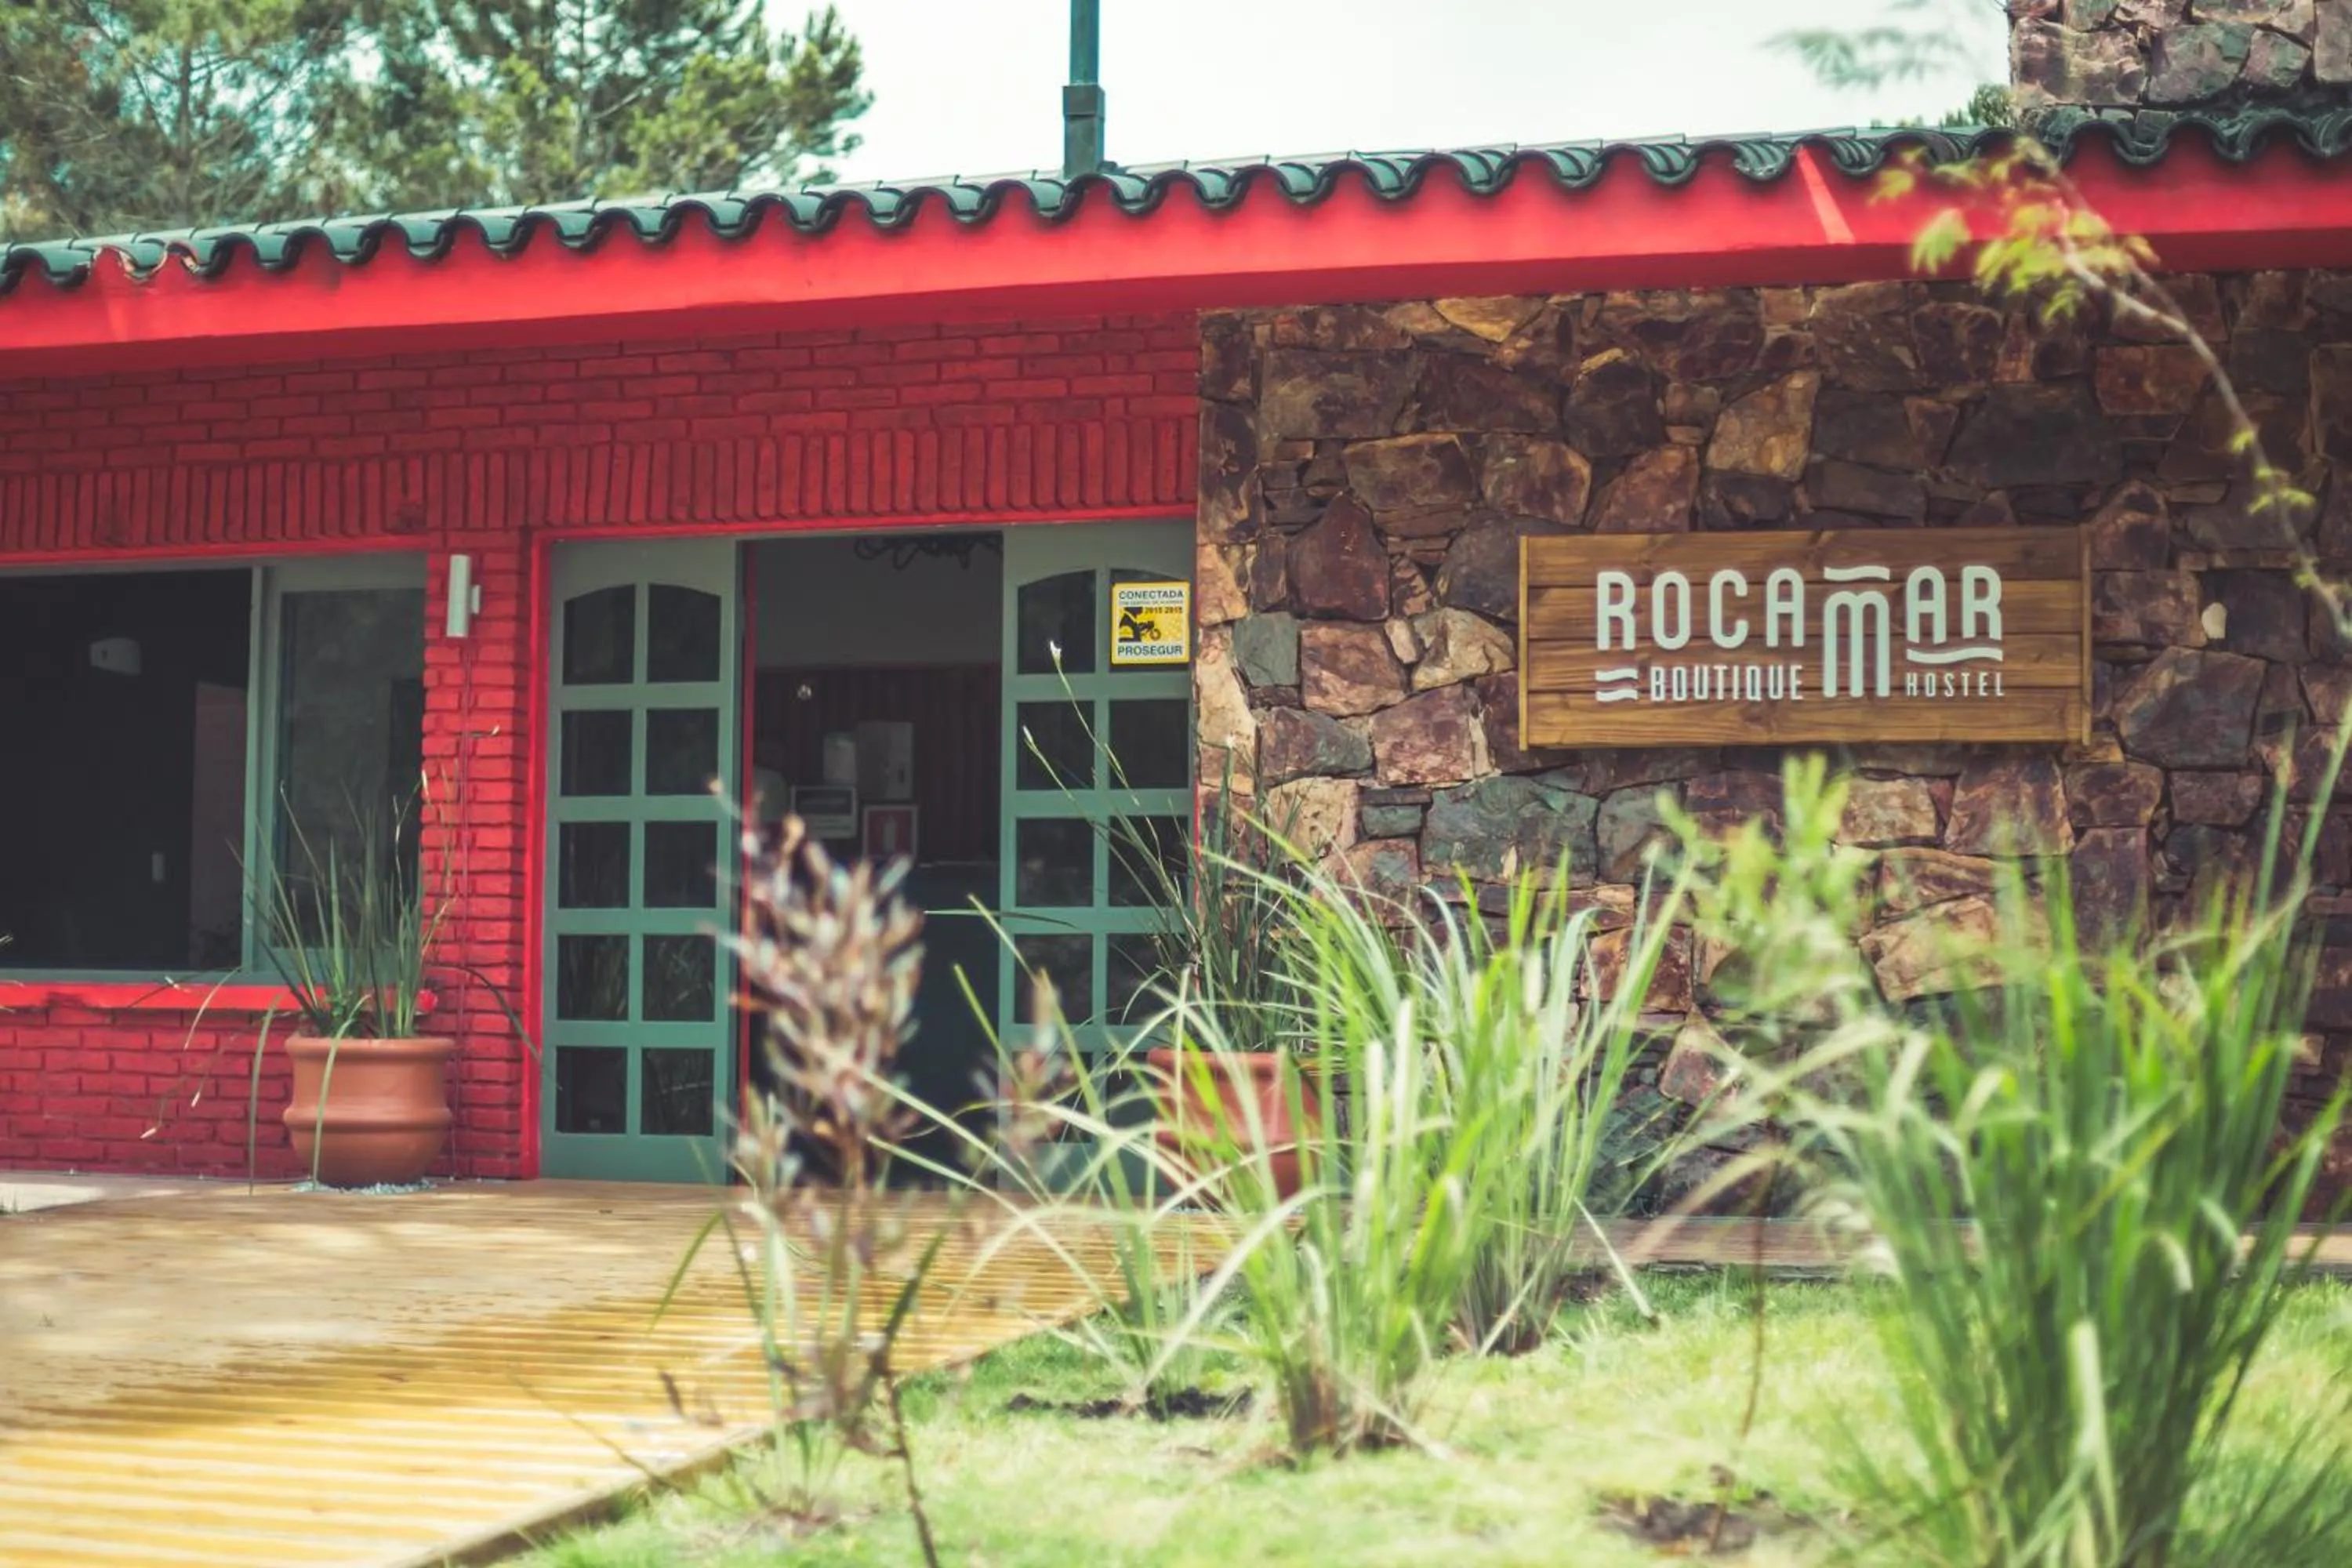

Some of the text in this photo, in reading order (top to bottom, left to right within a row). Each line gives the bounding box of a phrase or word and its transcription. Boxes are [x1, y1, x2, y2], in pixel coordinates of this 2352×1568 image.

[1119, 590, 1183, 600] CONECTADA
[1595, 565, 2002, 698] ROCAMAR
[1117, 645, 1183, 656] PROSEGUR
[1650, 664, 2005, 702] BOUTIQUE HOSTEL
